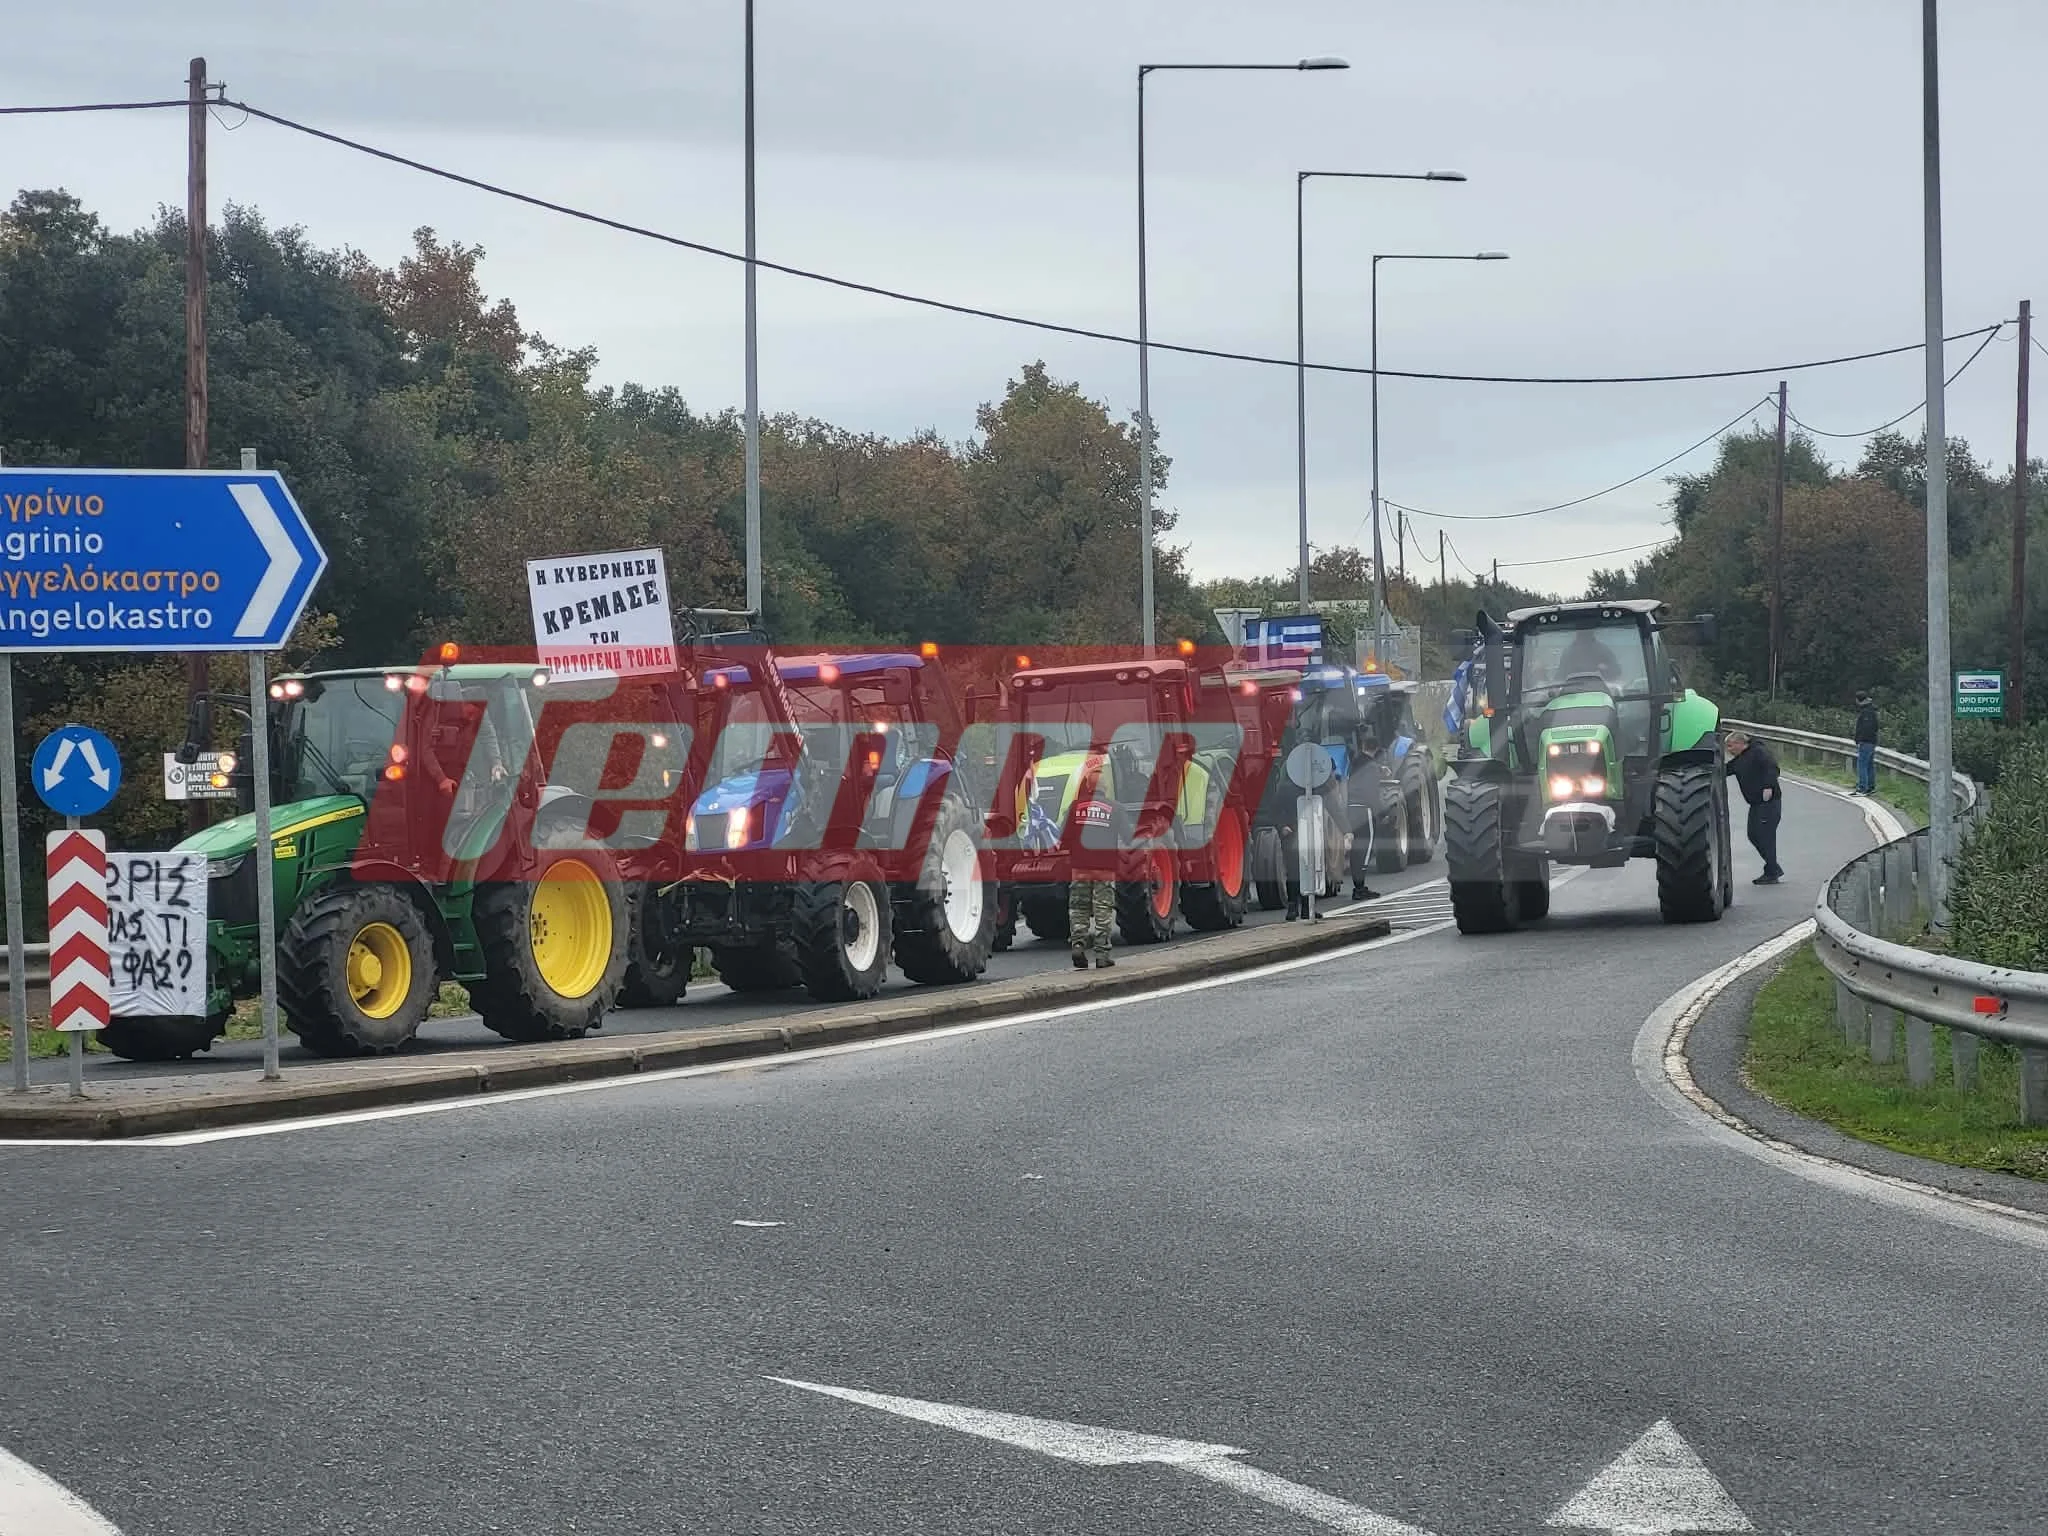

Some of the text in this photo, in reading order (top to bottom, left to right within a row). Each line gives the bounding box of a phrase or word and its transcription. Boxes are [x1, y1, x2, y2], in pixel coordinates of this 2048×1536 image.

[0, 487, 104, 522] γρίνιο
[0, 526, 103, 561] grinio
[536, 559, 657, 585] Η ΚΥΒΕΡΝΗΣΗ
[543, 580, 660, 635] ΚΡΕΜΑΣΕ
[590, 630, 619, 644] ΤΟΝ
[545, 646, 672, 675] ΠΡΩΤΟΓΕΝΗ ΤΟΜΕΑ
[156, 914, 188, 947] ΤΙ
